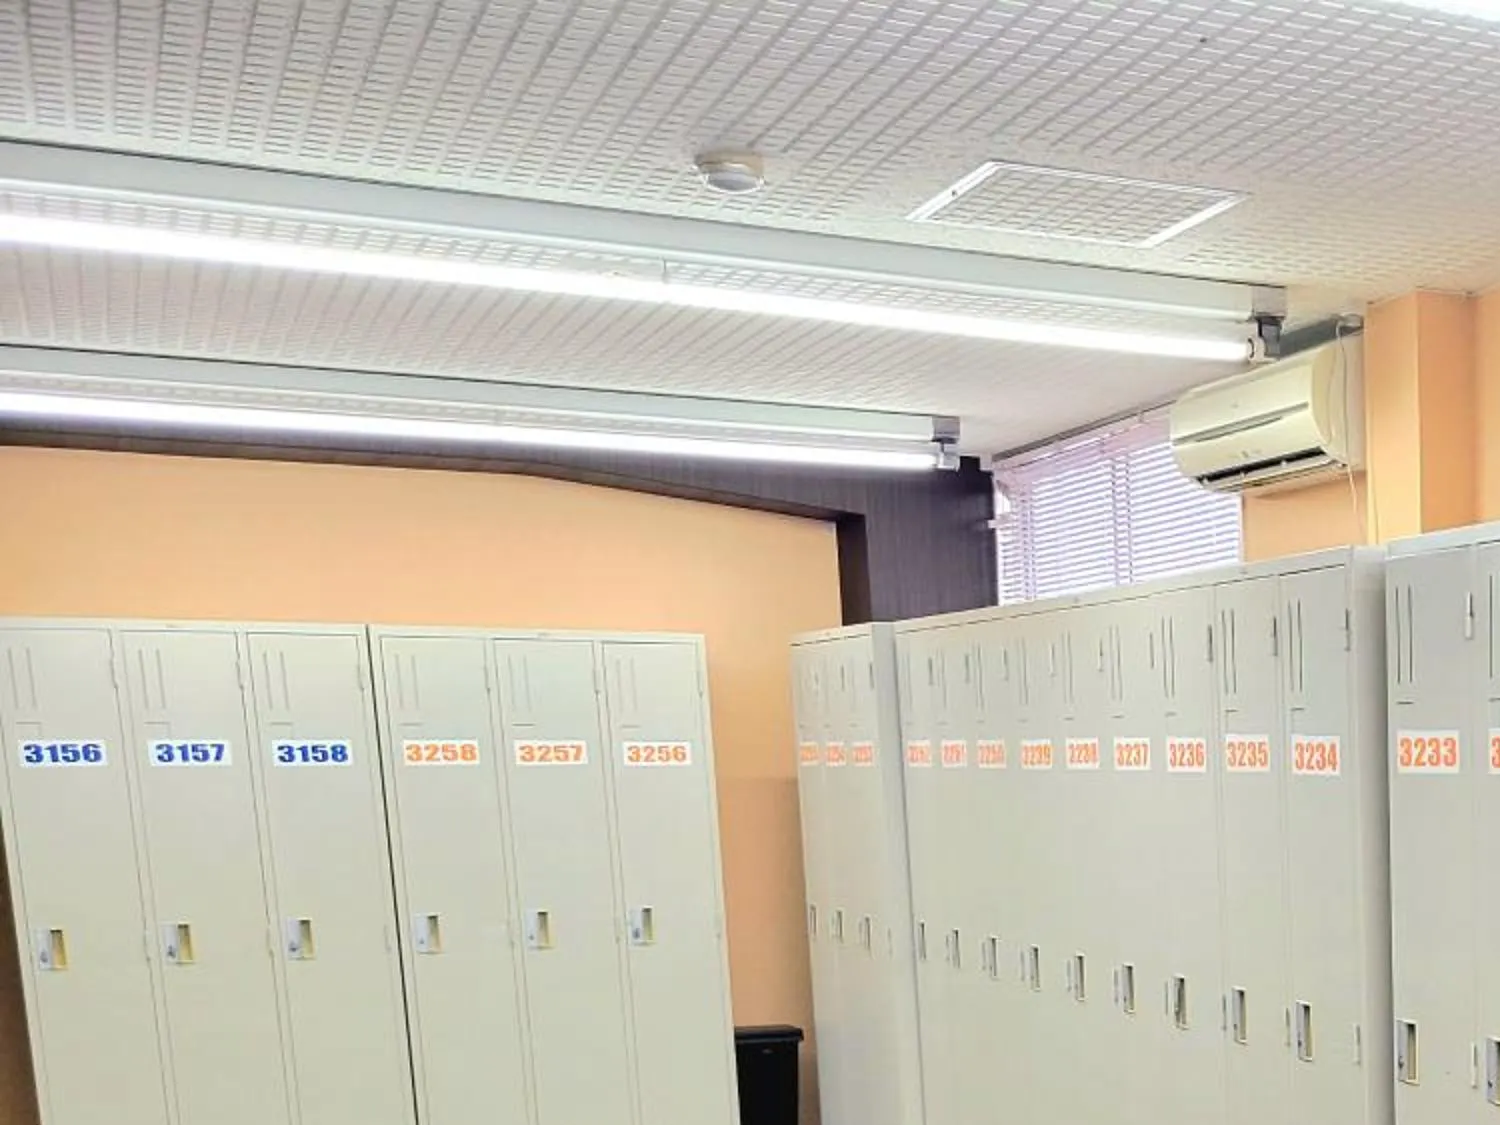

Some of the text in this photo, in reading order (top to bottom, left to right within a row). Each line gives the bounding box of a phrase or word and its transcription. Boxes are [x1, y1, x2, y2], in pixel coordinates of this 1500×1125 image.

[23, 743, 102, 763] 3156
[155, 743, 225, 763] 3157
[277, 744, 348, 763] 3158
[405, 743, 477, 762] 3258
[518, 744, 584, 762] 3257
[627, 745, 687, 763] 3256
[1116, 743, 1149, 766] 3237
[1169, 742, 1204, 768] 3236
[1227, 741, 1268, 767] 3235
[1294, 742, 1338, 771] 3234
[1399, 737, 1457, 767] 3233
